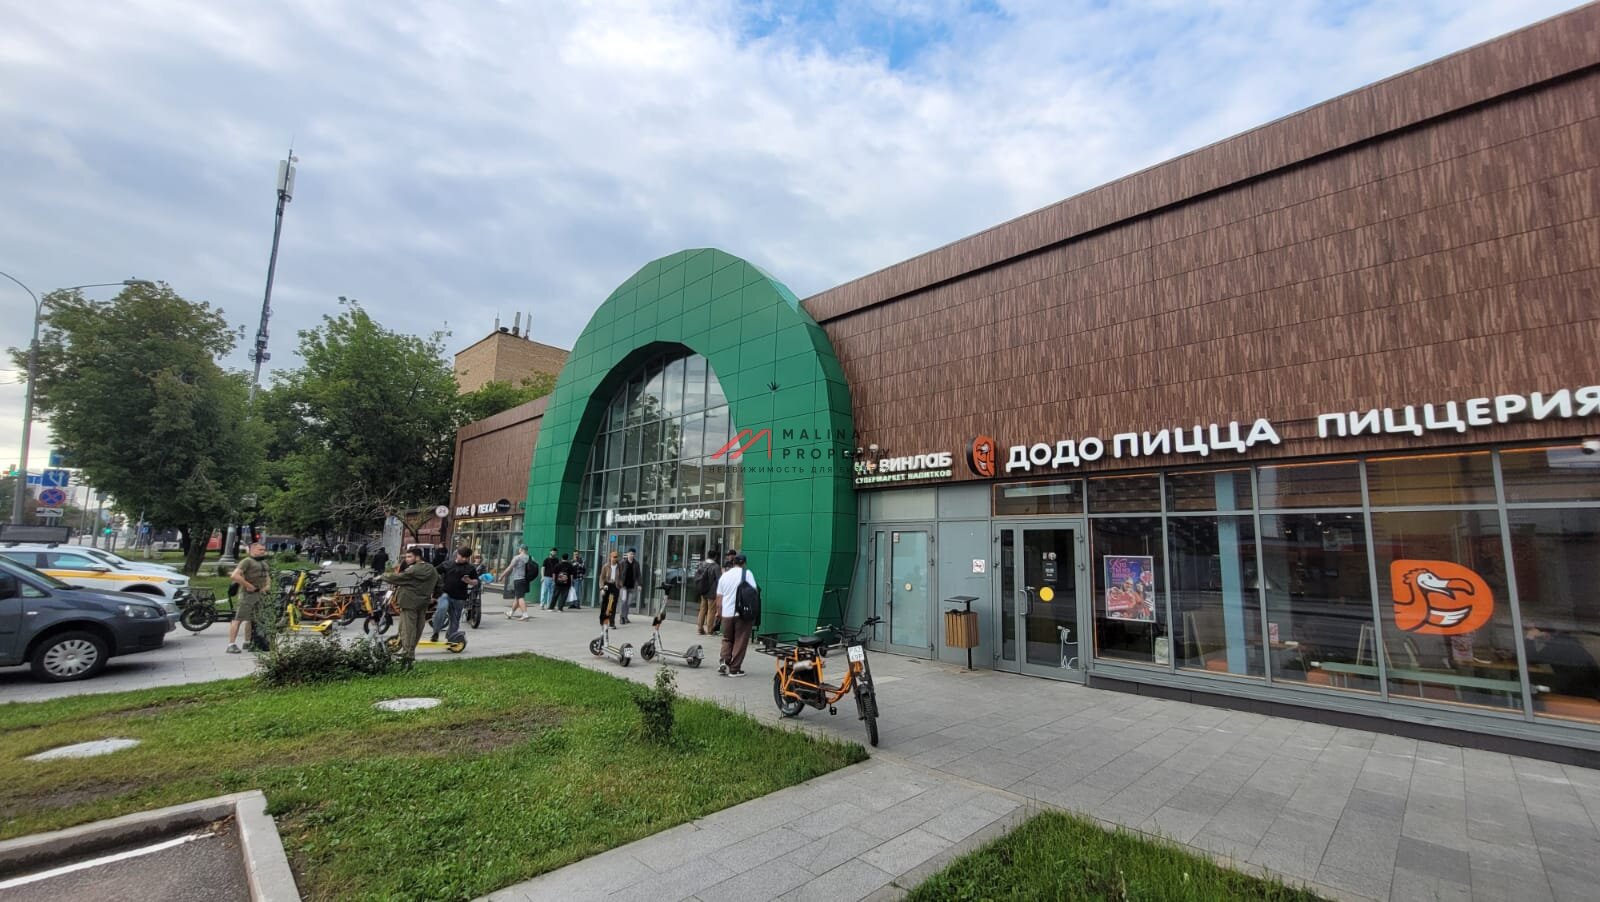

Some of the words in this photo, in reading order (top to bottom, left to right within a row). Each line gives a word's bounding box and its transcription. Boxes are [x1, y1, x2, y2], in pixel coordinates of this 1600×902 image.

[1317, 385, 1600, 438] ПИЦЦЕРИЯ
[1005, 437, 1104, 472] ДОДО
[1113, 418, 1281, 458] ПИЦЦА
[855, 473, 905, 484] СУПЕРМАРКЕТ
[907, 469, 953, 480] НАПИТКОВ
[689, 508, 704, 519] 450
